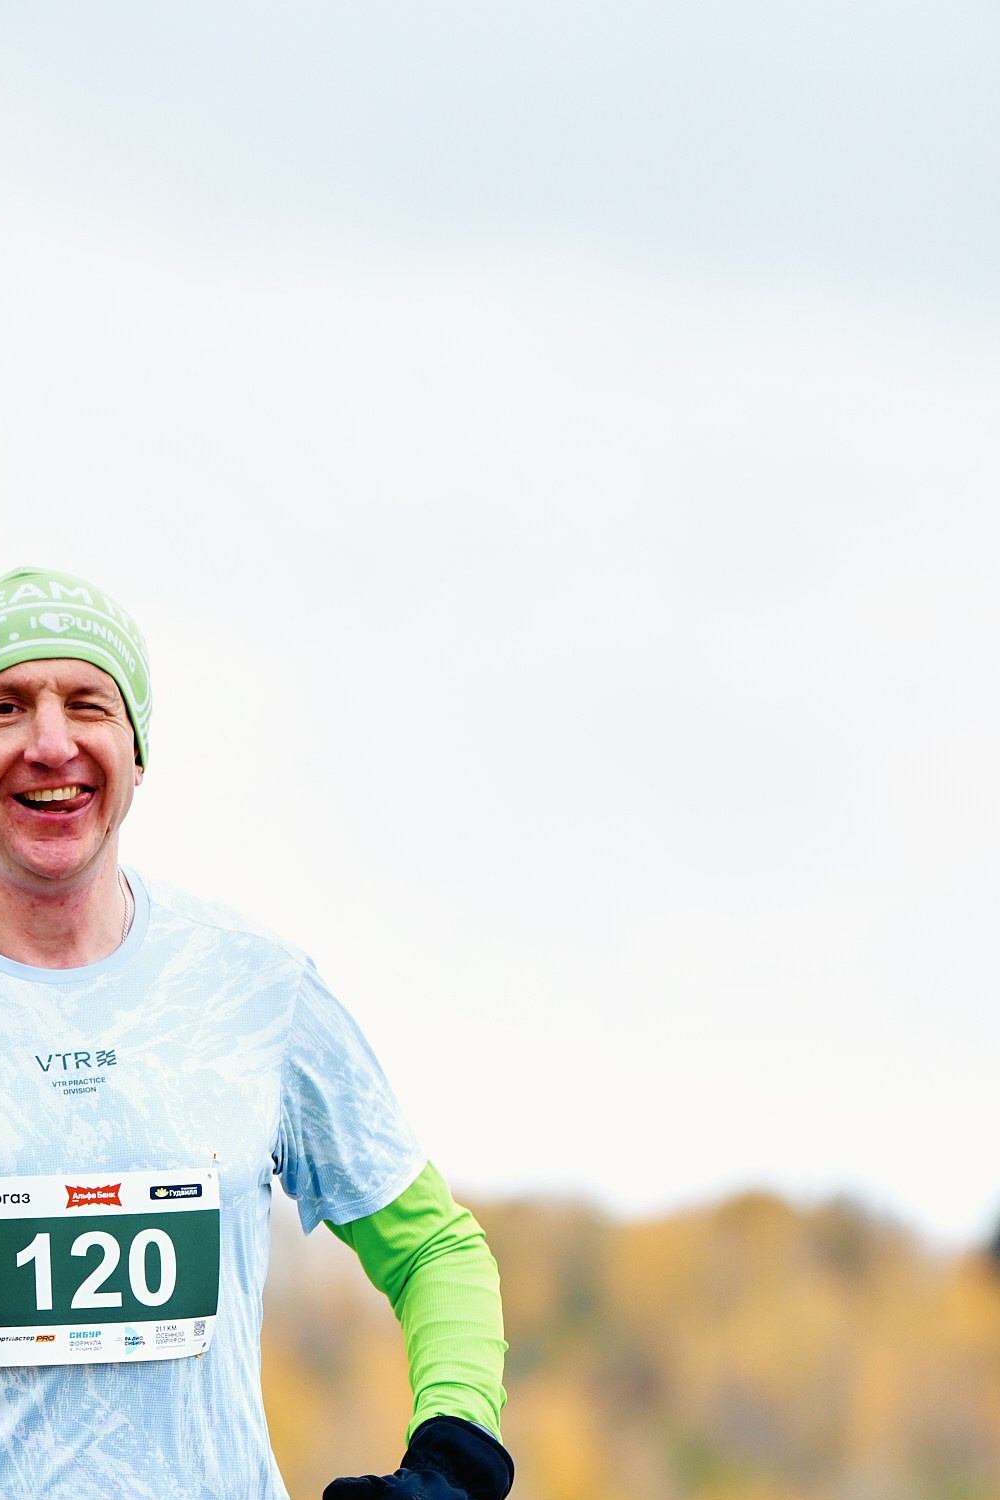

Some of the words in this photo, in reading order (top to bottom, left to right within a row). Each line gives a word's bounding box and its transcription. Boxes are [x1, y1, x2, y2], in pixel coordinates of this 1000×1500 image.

[57, 613, 136, 675] RUNNING
[34, 1051, 92, 1072] VTR
[51, 1080, 68, 1088] VTR
[68, 1076, 106, 1087] PRACTICE
[63, 1086, 97, 1096] DIVISION
[72, 1192, 96, 1202] Альфа
[97, 1191, 116, 1199] Банк
[169, 1189, 198, 1197] Гудвилл
[16, 1228, 177, 1311] 120
[69, 1331, 102, 1339] СИБУР
